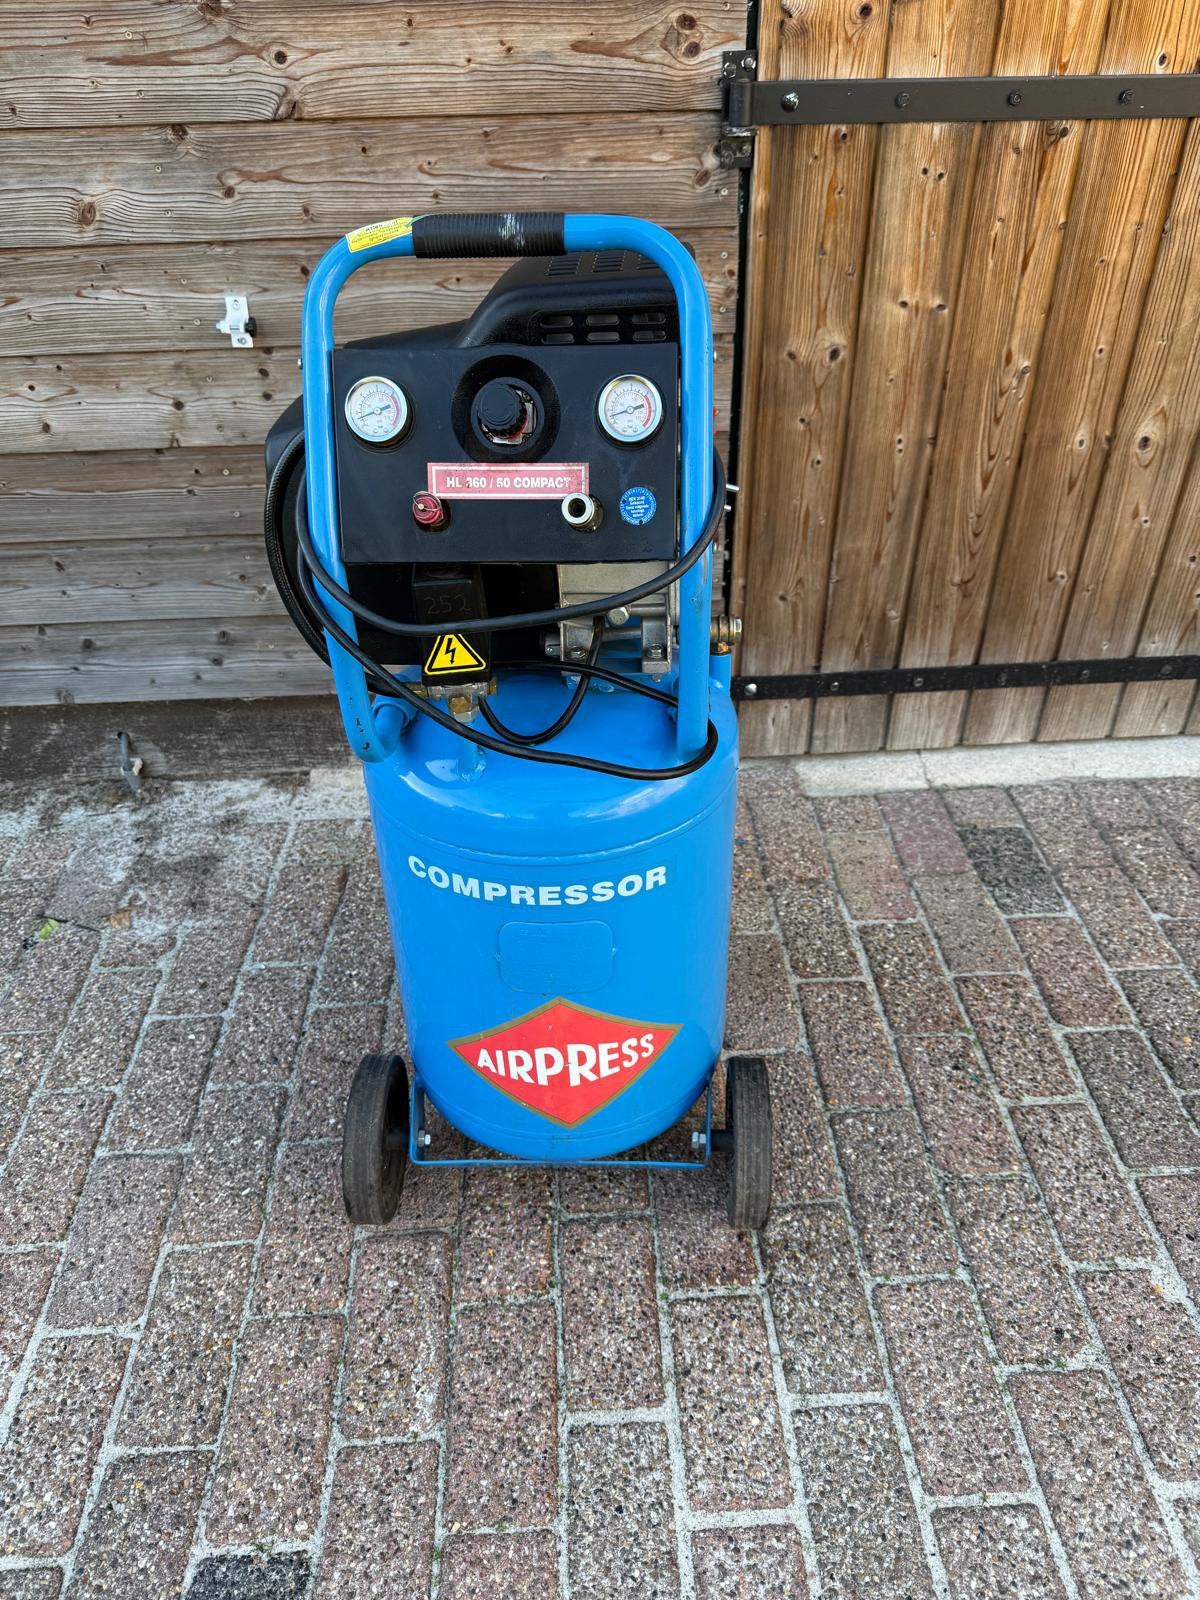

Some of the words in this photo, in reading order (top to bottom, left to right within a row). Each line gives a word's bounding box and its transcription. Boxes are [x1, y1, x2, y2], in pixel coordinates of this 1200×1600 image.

[446, 477, 462, 488] HL
[465, 476, 487, 488] 360
[496, 476, 511, 488] 50
[513, 476, 572, 489] COMPACT
[407, 855, 667, 906] COMPRESSOR
[476, 1033, 655, 1087] AIRPRESS
